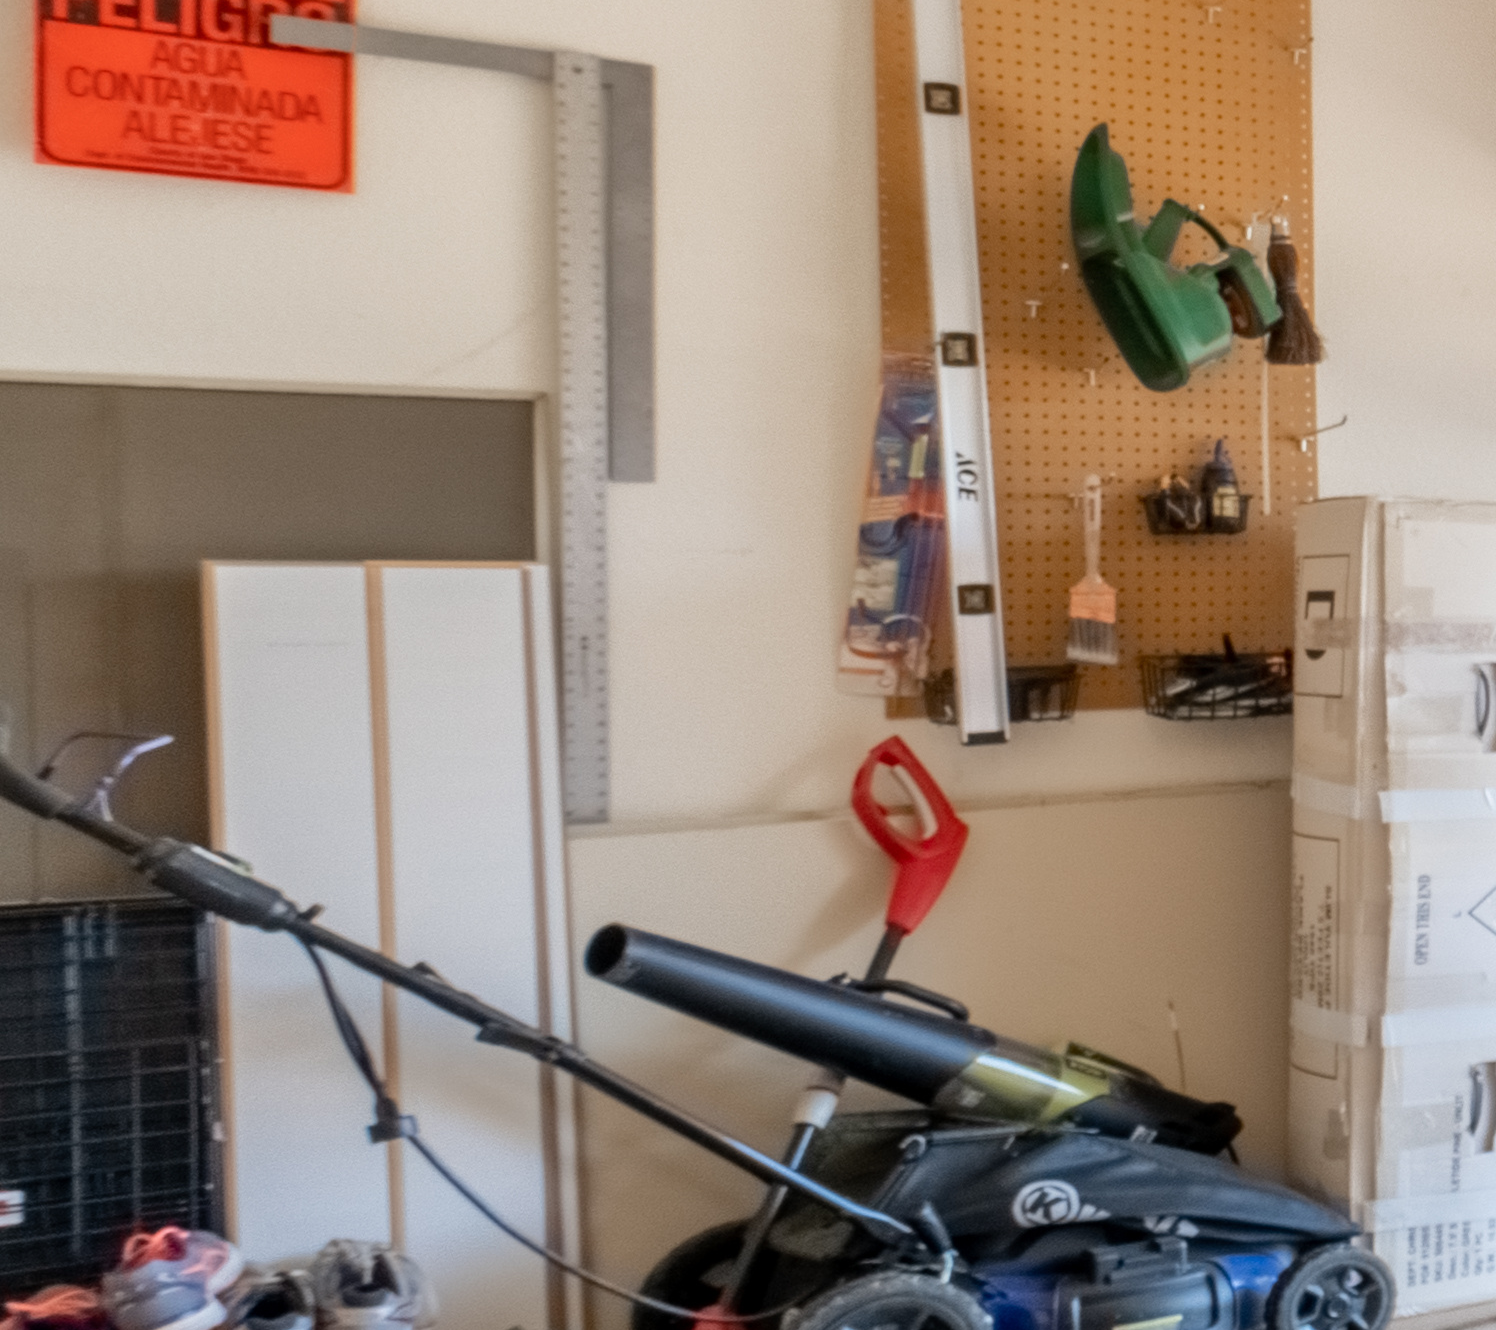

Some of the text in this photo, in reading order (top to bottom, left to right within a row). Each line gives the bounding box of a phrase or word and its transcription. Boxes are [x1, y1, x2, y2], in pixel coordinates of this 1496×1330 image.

[151, 39, 248, 80] AGUA
[64, 66, 325, 124] CONTAMINADA
[121, 110, 274, 155] ALEJESE
[955, 452, 979, 502] ACE
[1414, 874, 1432, 966] OPEN THIS END
